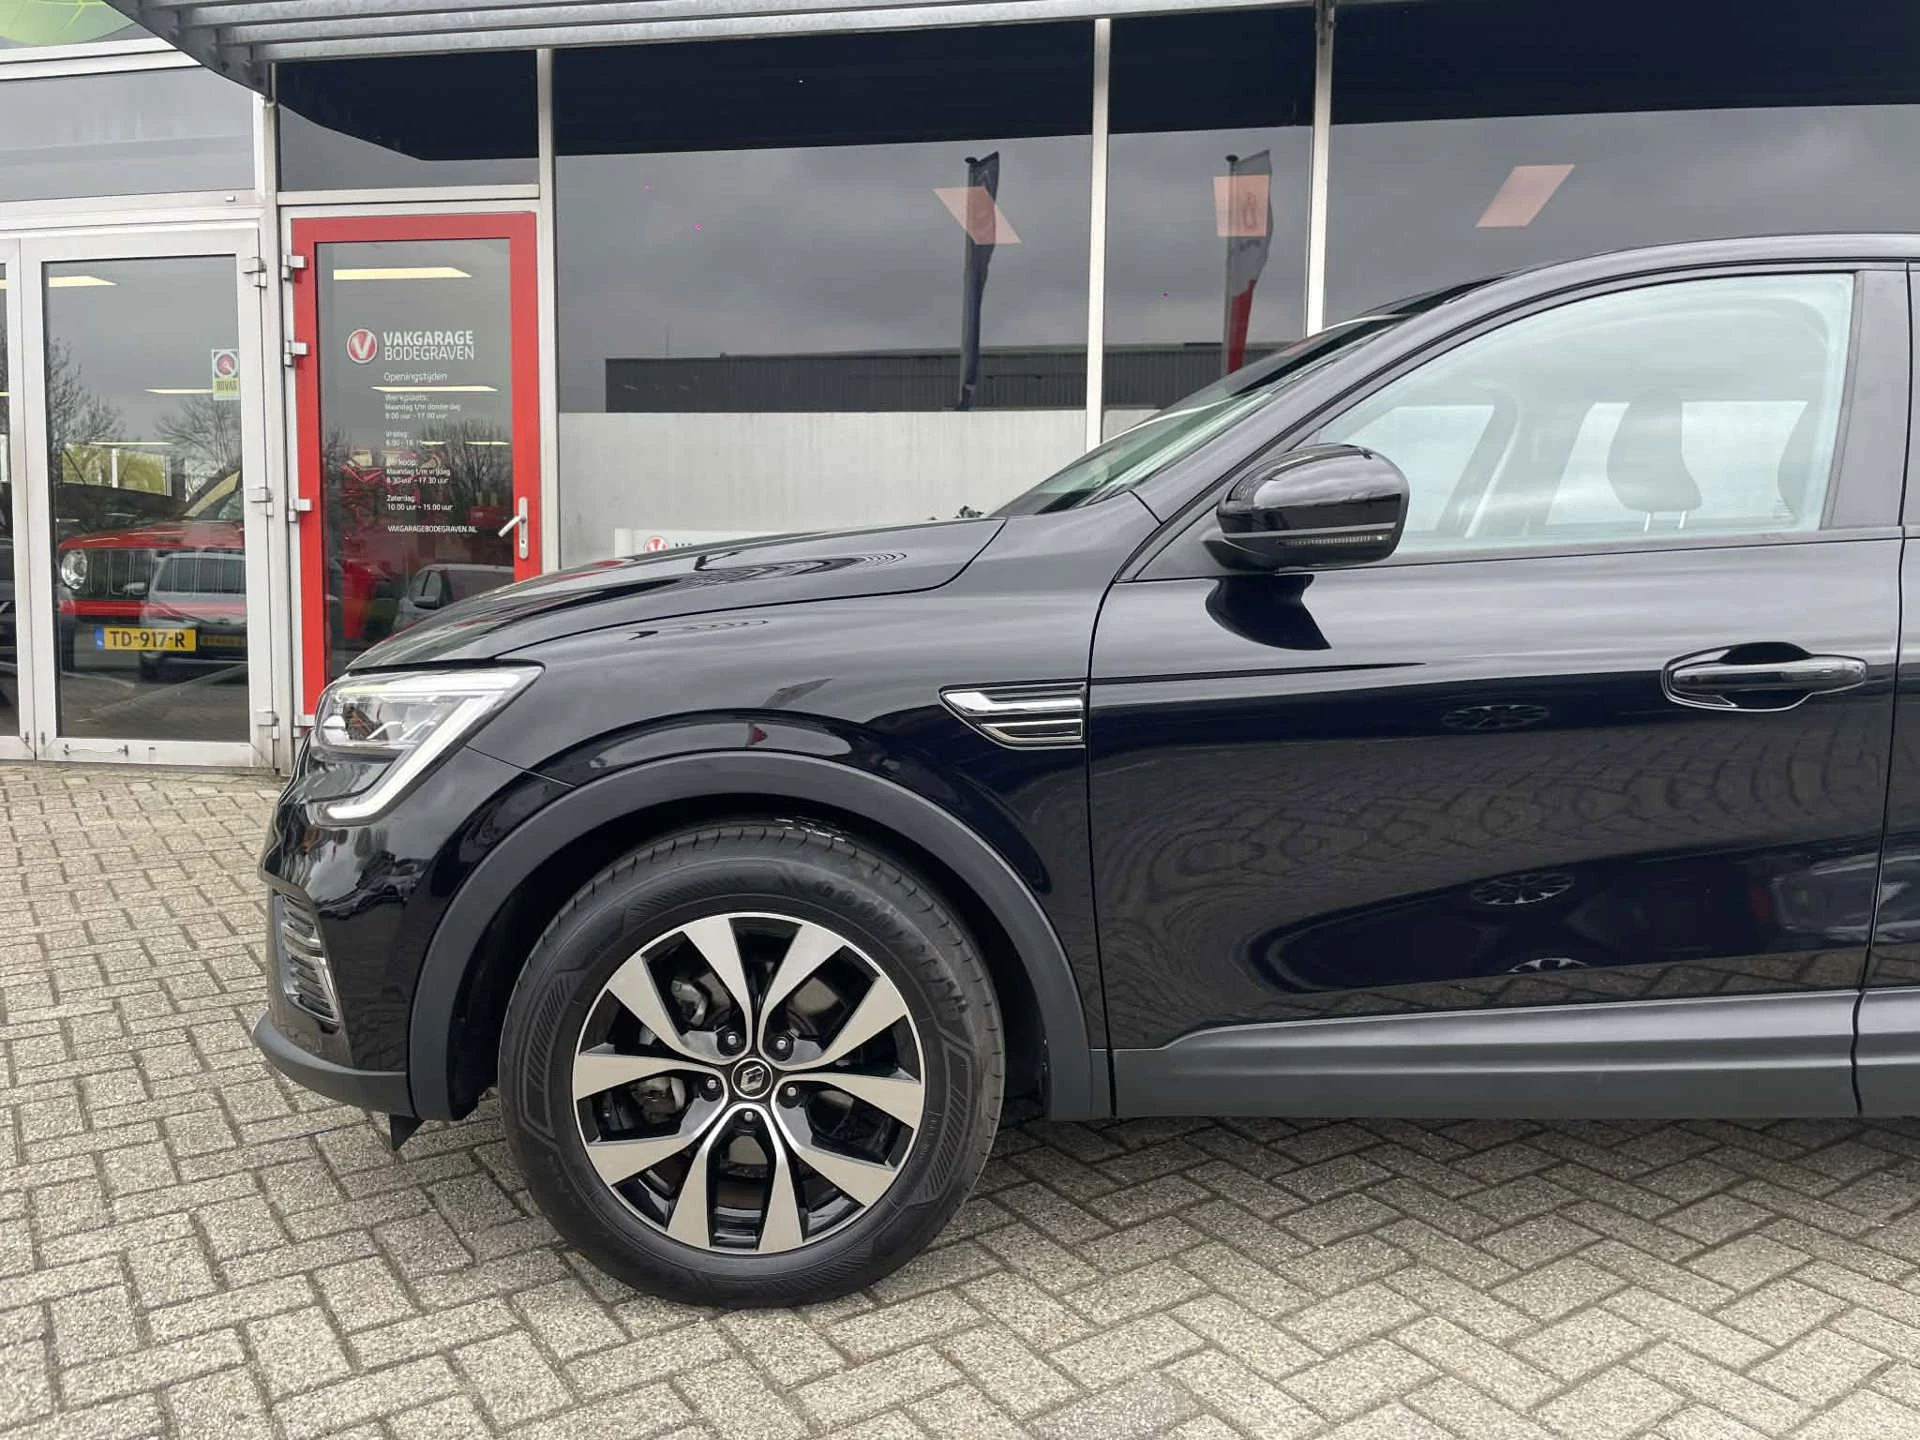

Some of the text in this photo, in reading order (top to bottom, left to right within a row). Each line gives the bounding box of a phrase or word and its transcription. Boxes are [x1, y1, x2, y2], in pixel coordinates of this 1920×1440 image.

[383, 331, 474, 345] VAKGARAGE
[385, 346, 475, 360] BODEGRAVEN
[383, 371, 448, 384] Openingstijden
[387, 525, 479, 534] VAKGARAGEBODEGRAVEN.NL
[109, 630, 186, 648] TD-917-R
